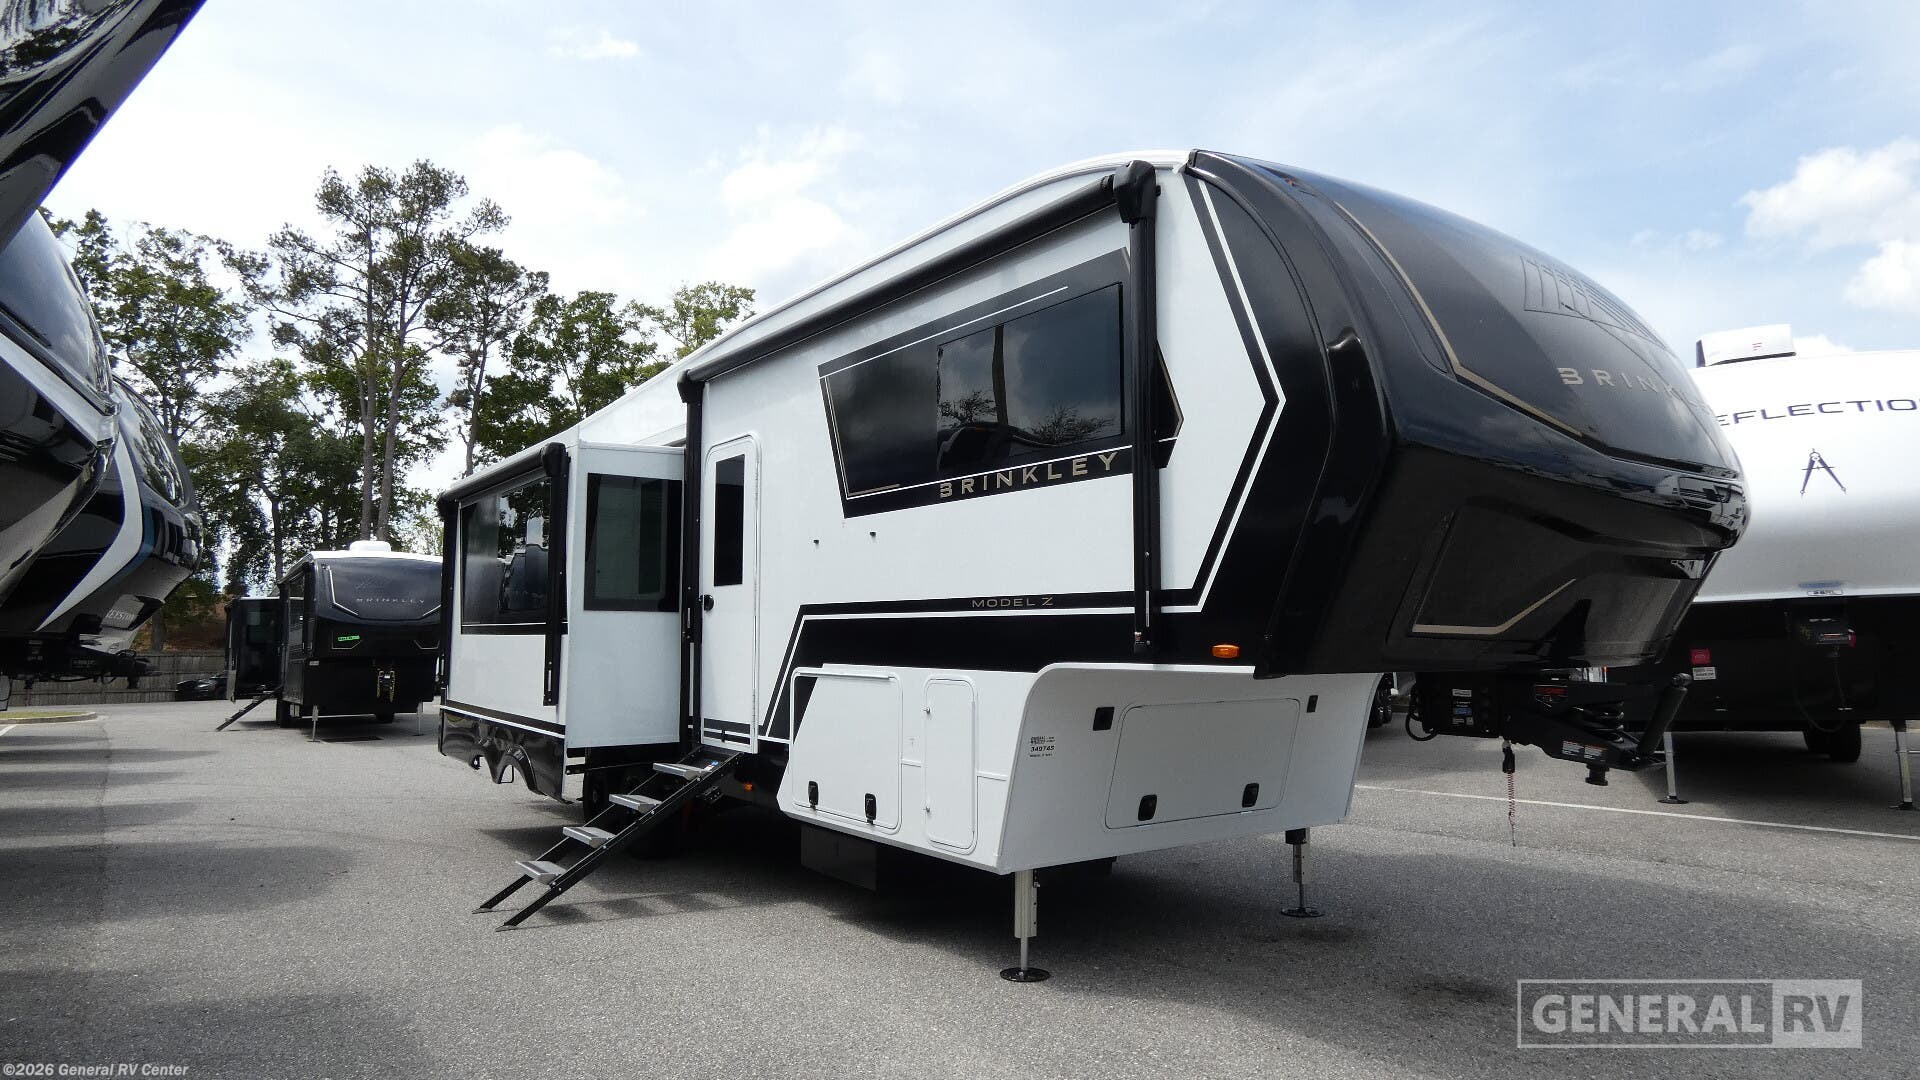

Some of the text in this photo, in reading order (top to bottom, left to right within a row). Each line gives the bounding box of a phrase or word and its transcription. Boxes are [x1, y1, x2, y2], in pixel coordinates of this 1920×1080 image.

[940, 452, 1118, 498] BRINKLEY
[972, 597, 1053, 608] MODEL Z
